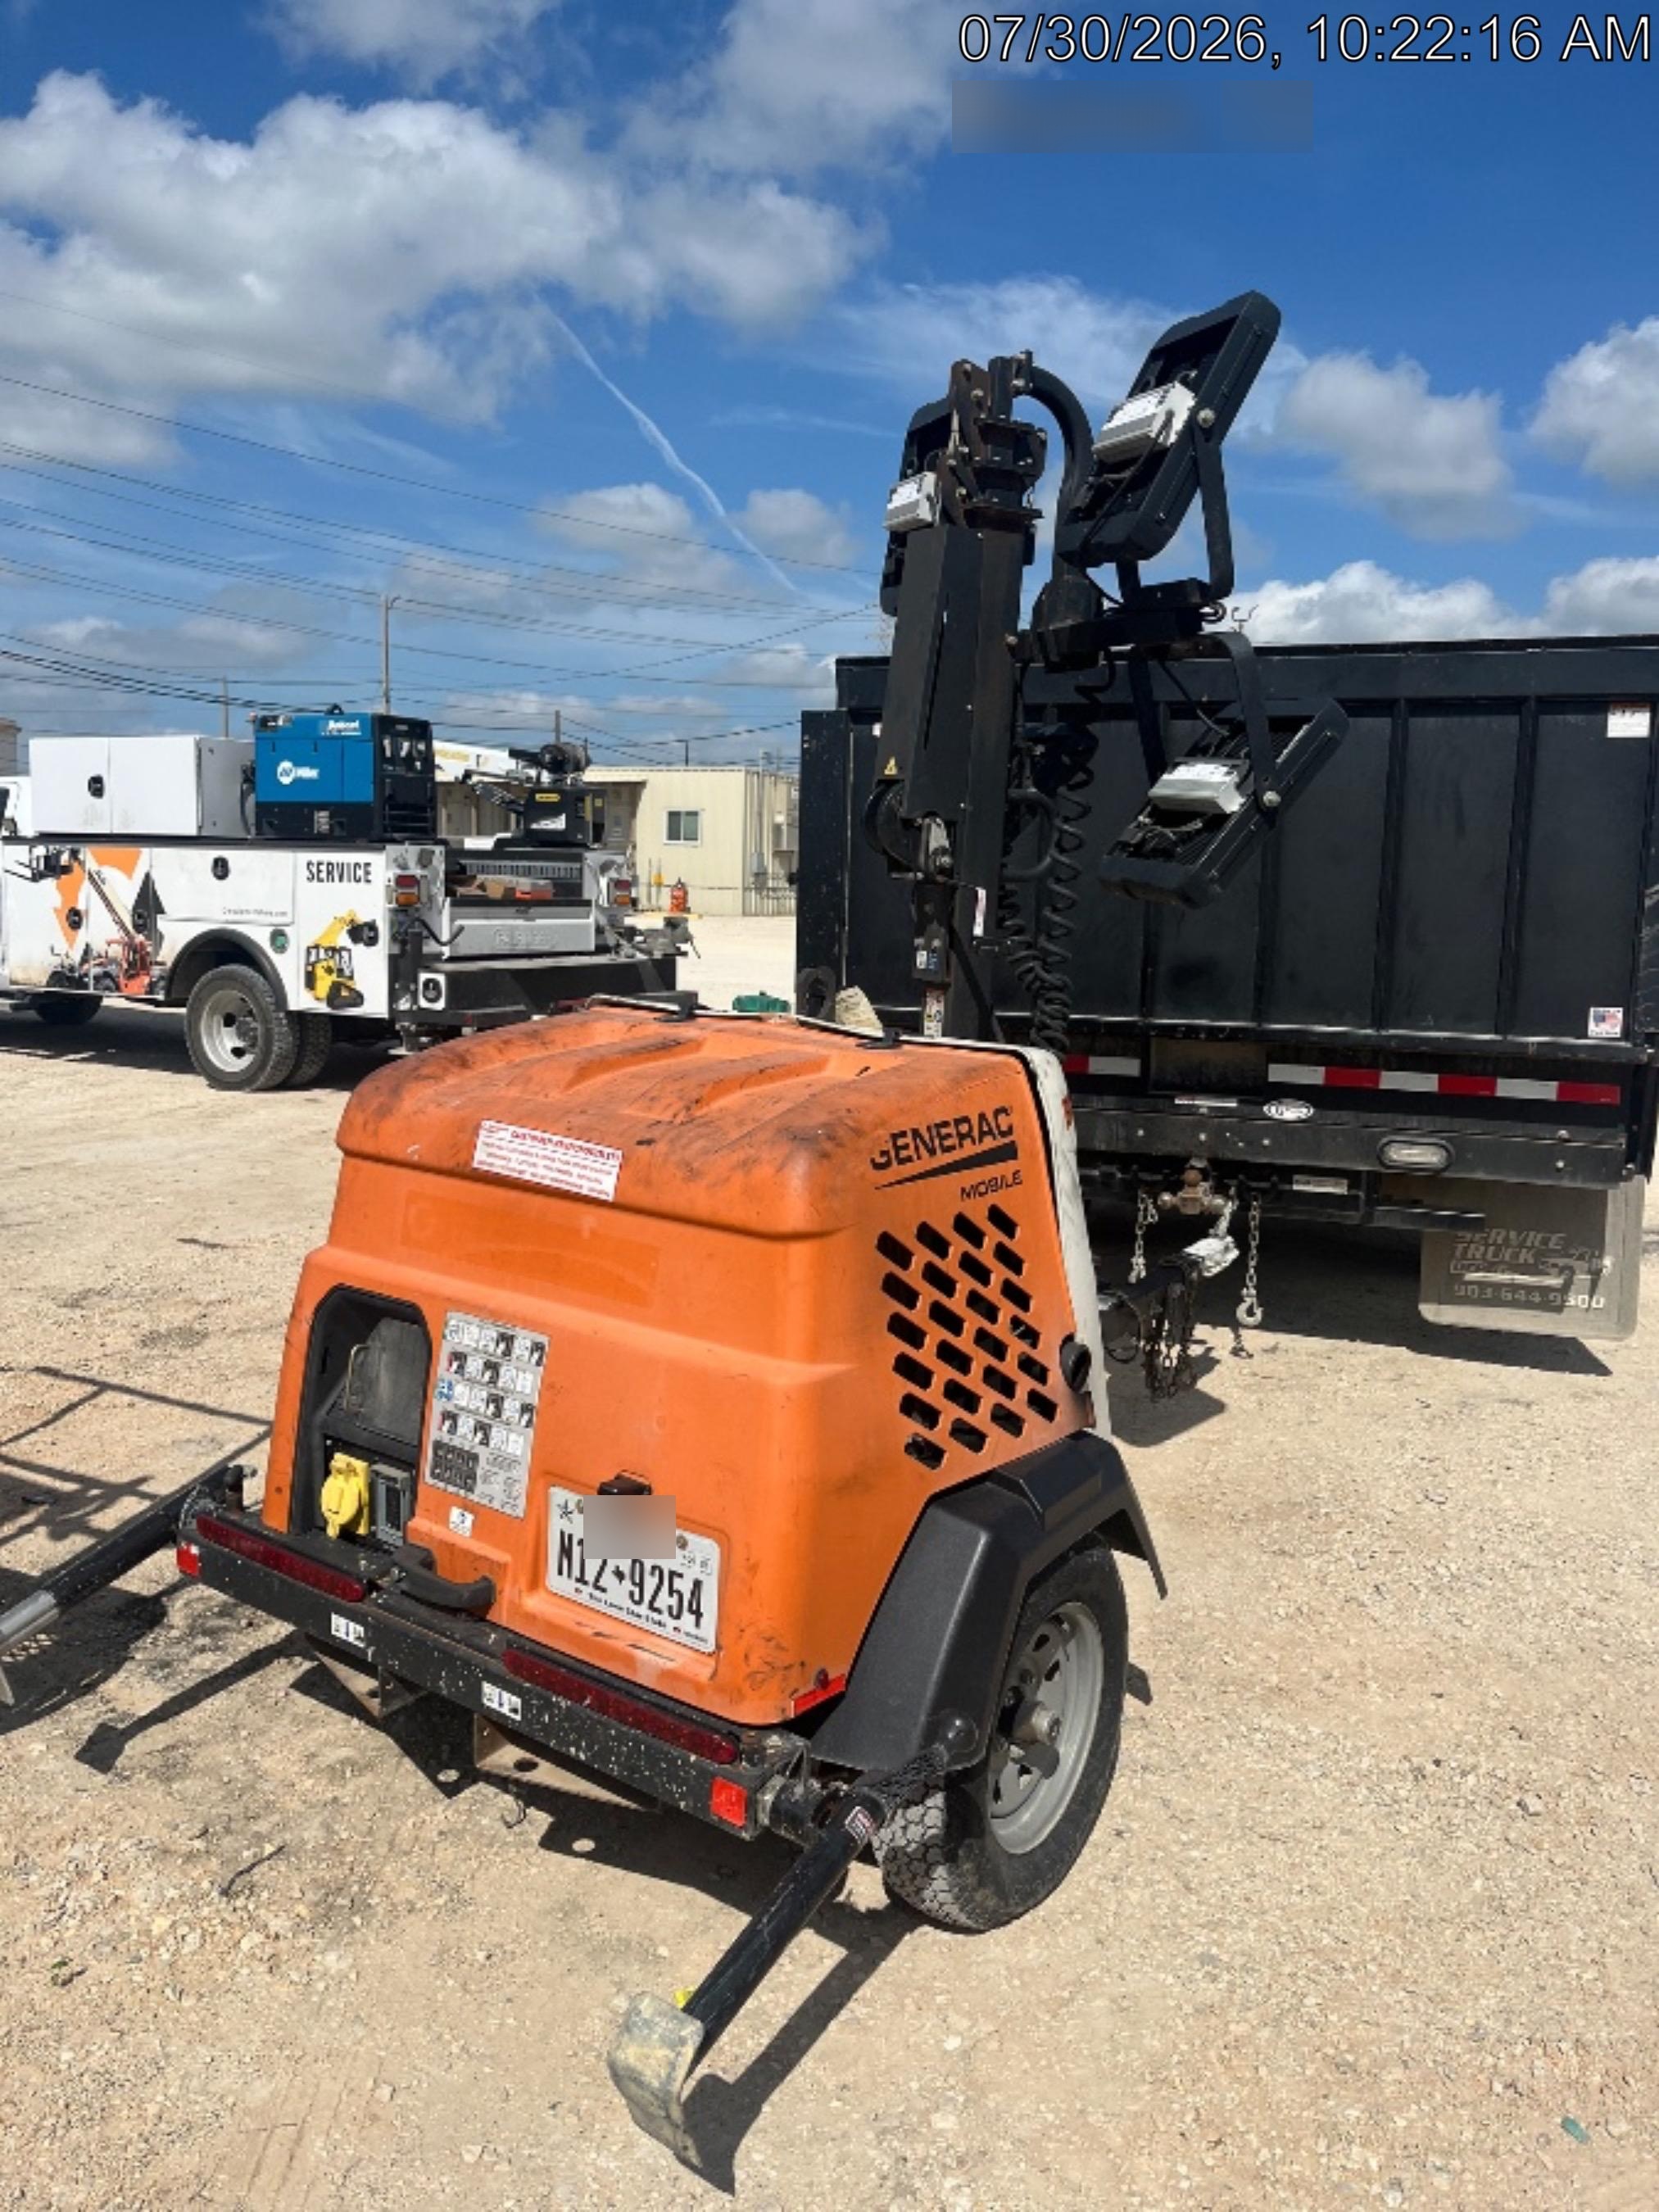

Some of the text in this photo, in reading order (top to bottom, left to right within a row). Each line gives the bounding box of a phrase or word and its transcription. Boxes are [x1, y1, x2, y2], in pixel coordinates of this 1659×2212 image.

[306, 860, 372, 883] SERVICE
[869, 1105, 1013, 1171] GENERAC
[959, 1169, 1023, 1202] MOBILE
[1454, 1228, 1566, 1250] SERVICE
[1453, 1242, 1538, 1265] TRUCK
[628, 1557, 704, 1629] 9254
